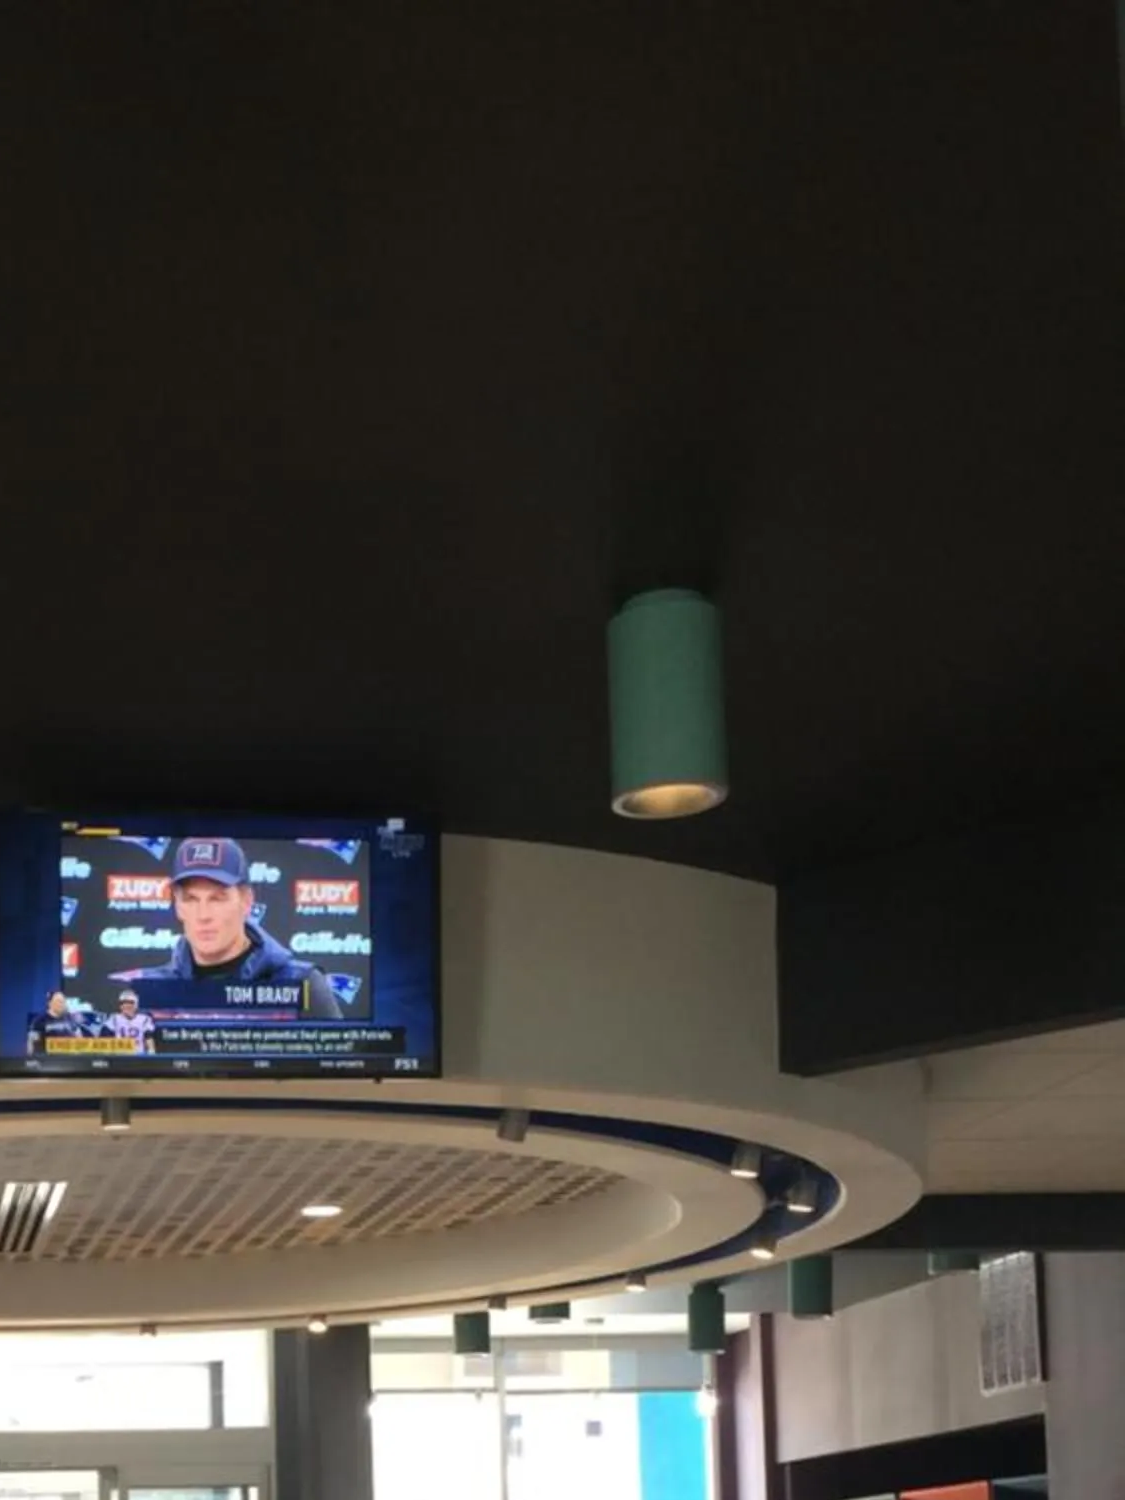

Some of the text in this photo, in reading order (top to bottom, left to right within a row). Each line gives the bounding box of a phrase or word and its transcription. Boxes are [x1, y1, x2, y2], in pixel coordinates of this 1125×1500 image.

[113, 879, 165, 898] ZUDY
[297, 882, 353, 902] ZUDY
[225, 985, 300, 1004] TOM BRADY
[394, 1058, 419, 1070] FS1
